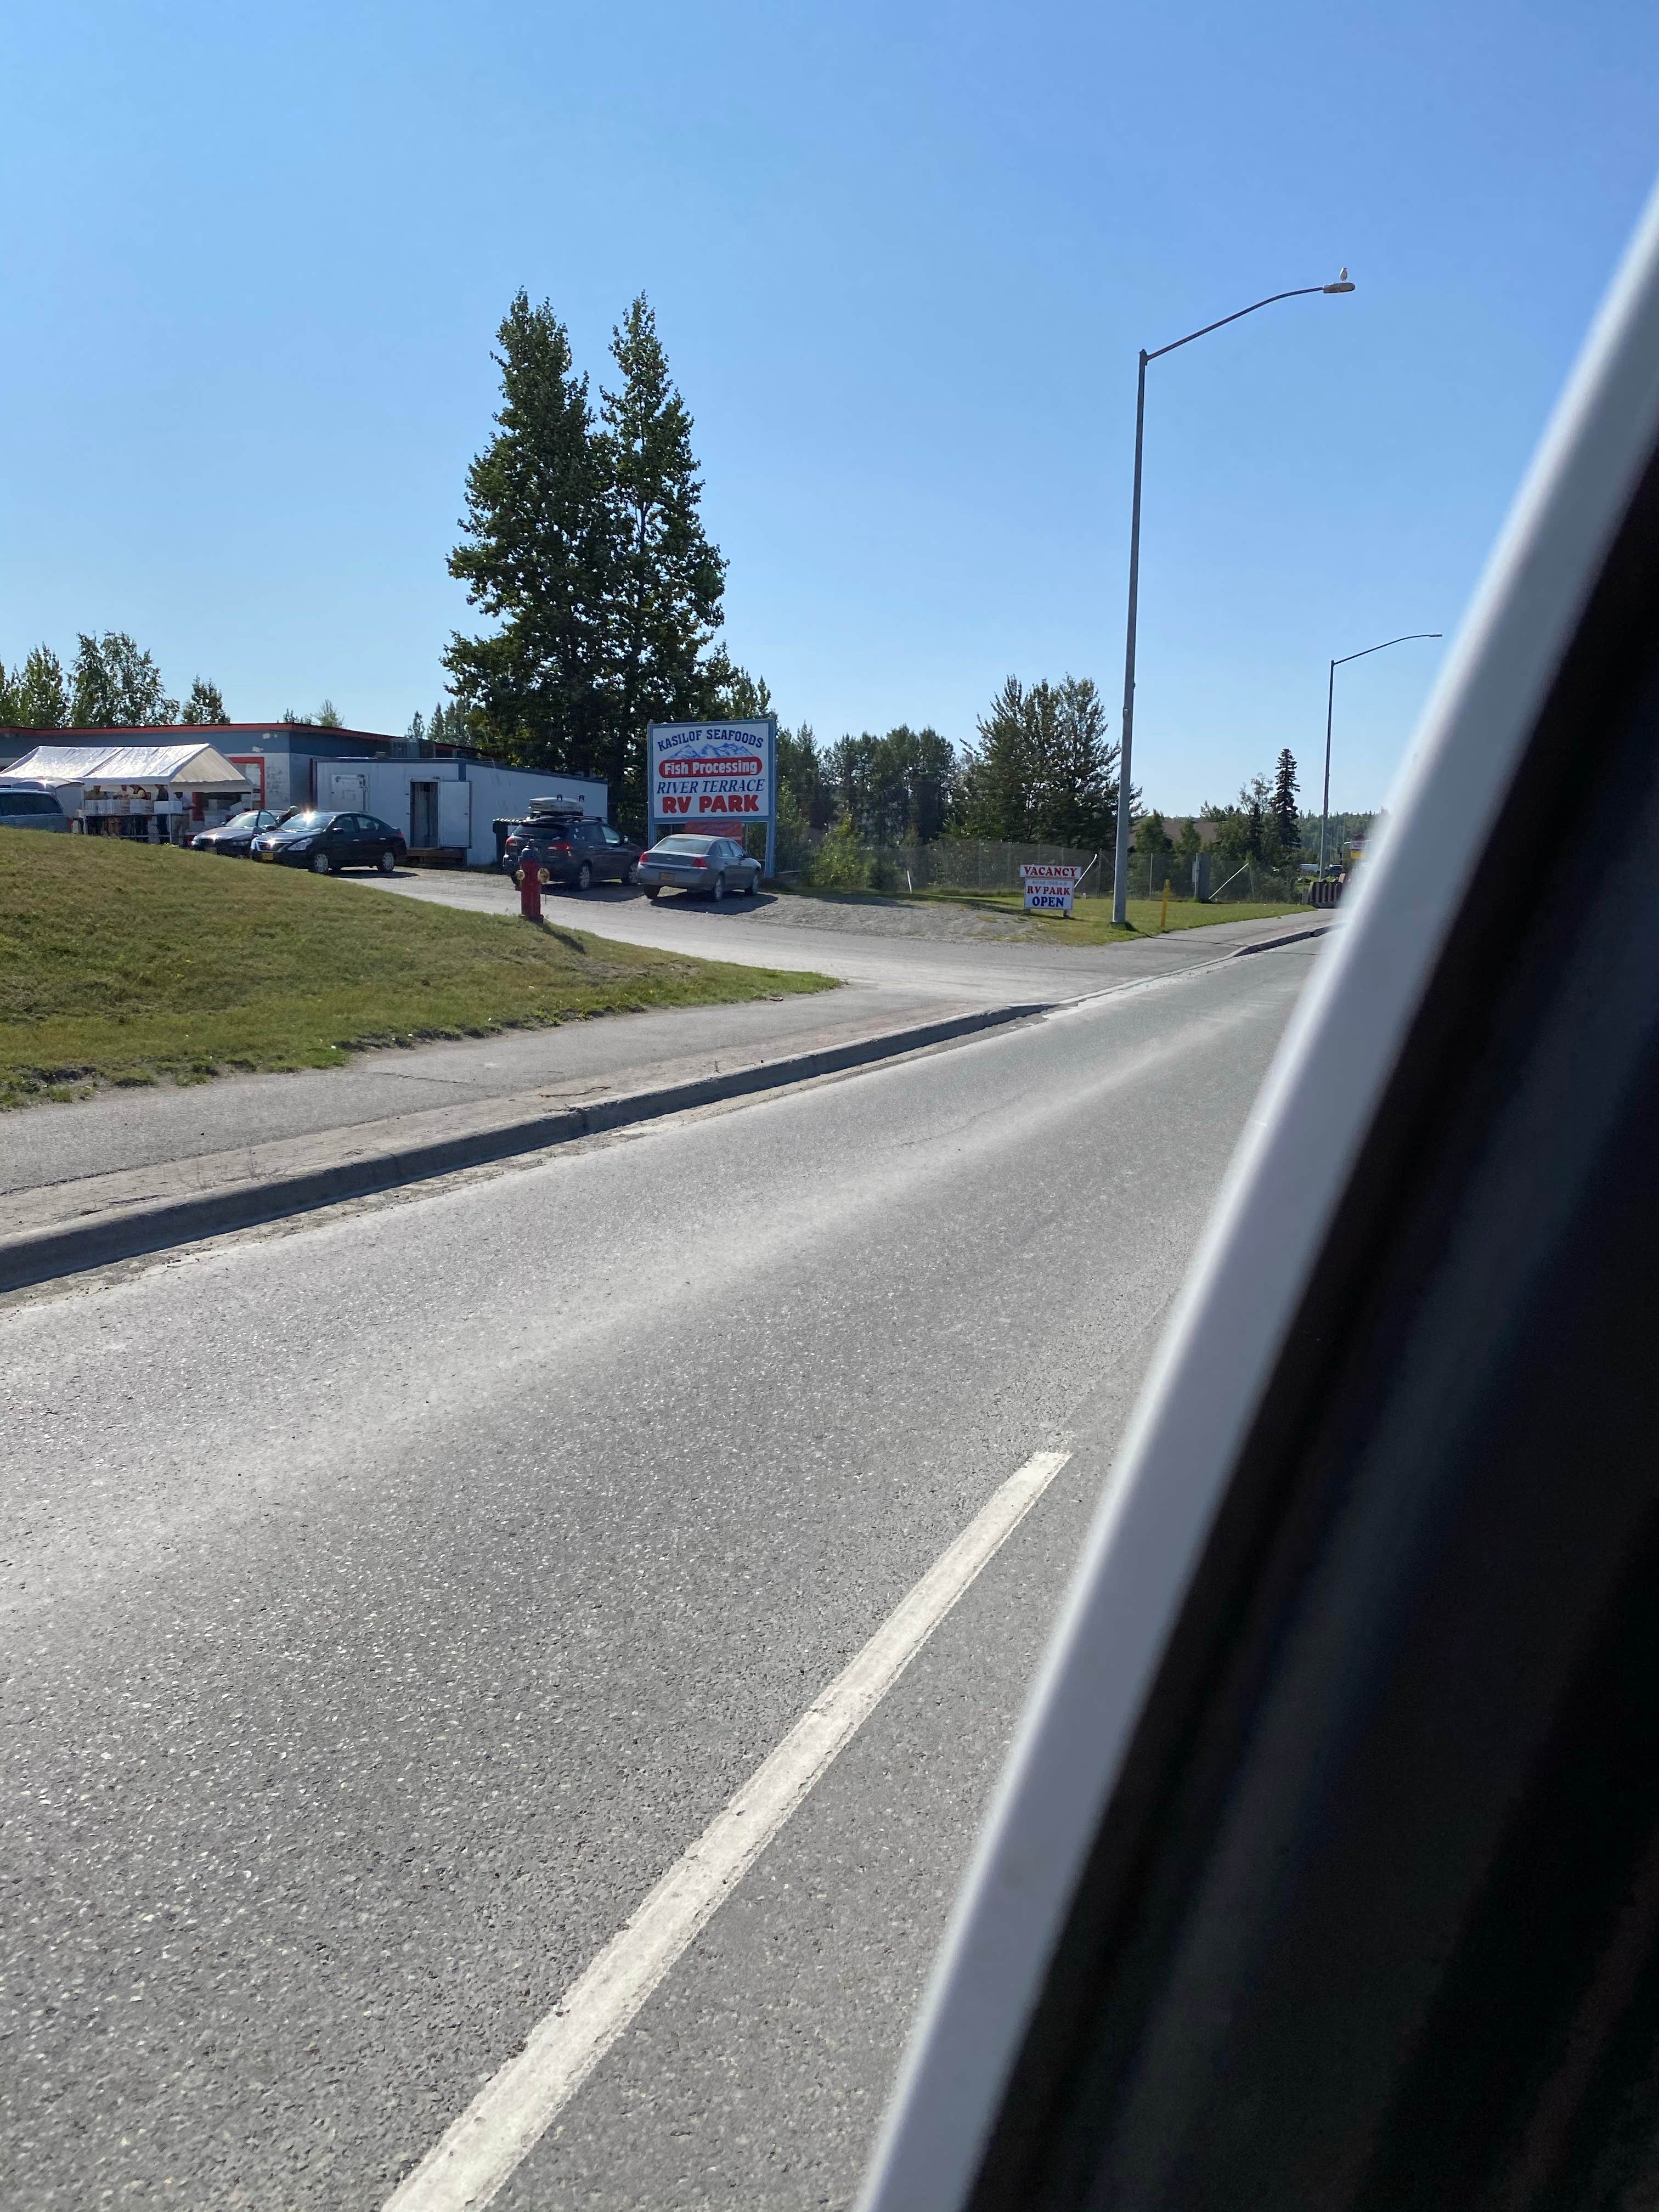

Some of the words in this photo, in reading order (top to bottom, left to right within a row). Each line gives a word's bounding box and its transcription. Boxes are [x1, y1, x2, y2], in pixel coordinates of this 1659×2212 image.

[657, 730, 702, 751] KASILOF
[706, 729, 764, 748] SEAFOODS
[664, 762, 689, 775] Fish
[692, 760, 758, 774] Processing
[657, 781, 698, 794] RIVER
[702, 779, 765, 793] TERRACE
[662, 796, 692, 814] RV
[699, 794, 759, 813] PARK
[1024, 866, 1077, 877] VACANCY
[1027, 885, 1041, 894] RV
[1043, 886, 1070, 895] PARK
[1032, 896, 1064, 907] OPEN
